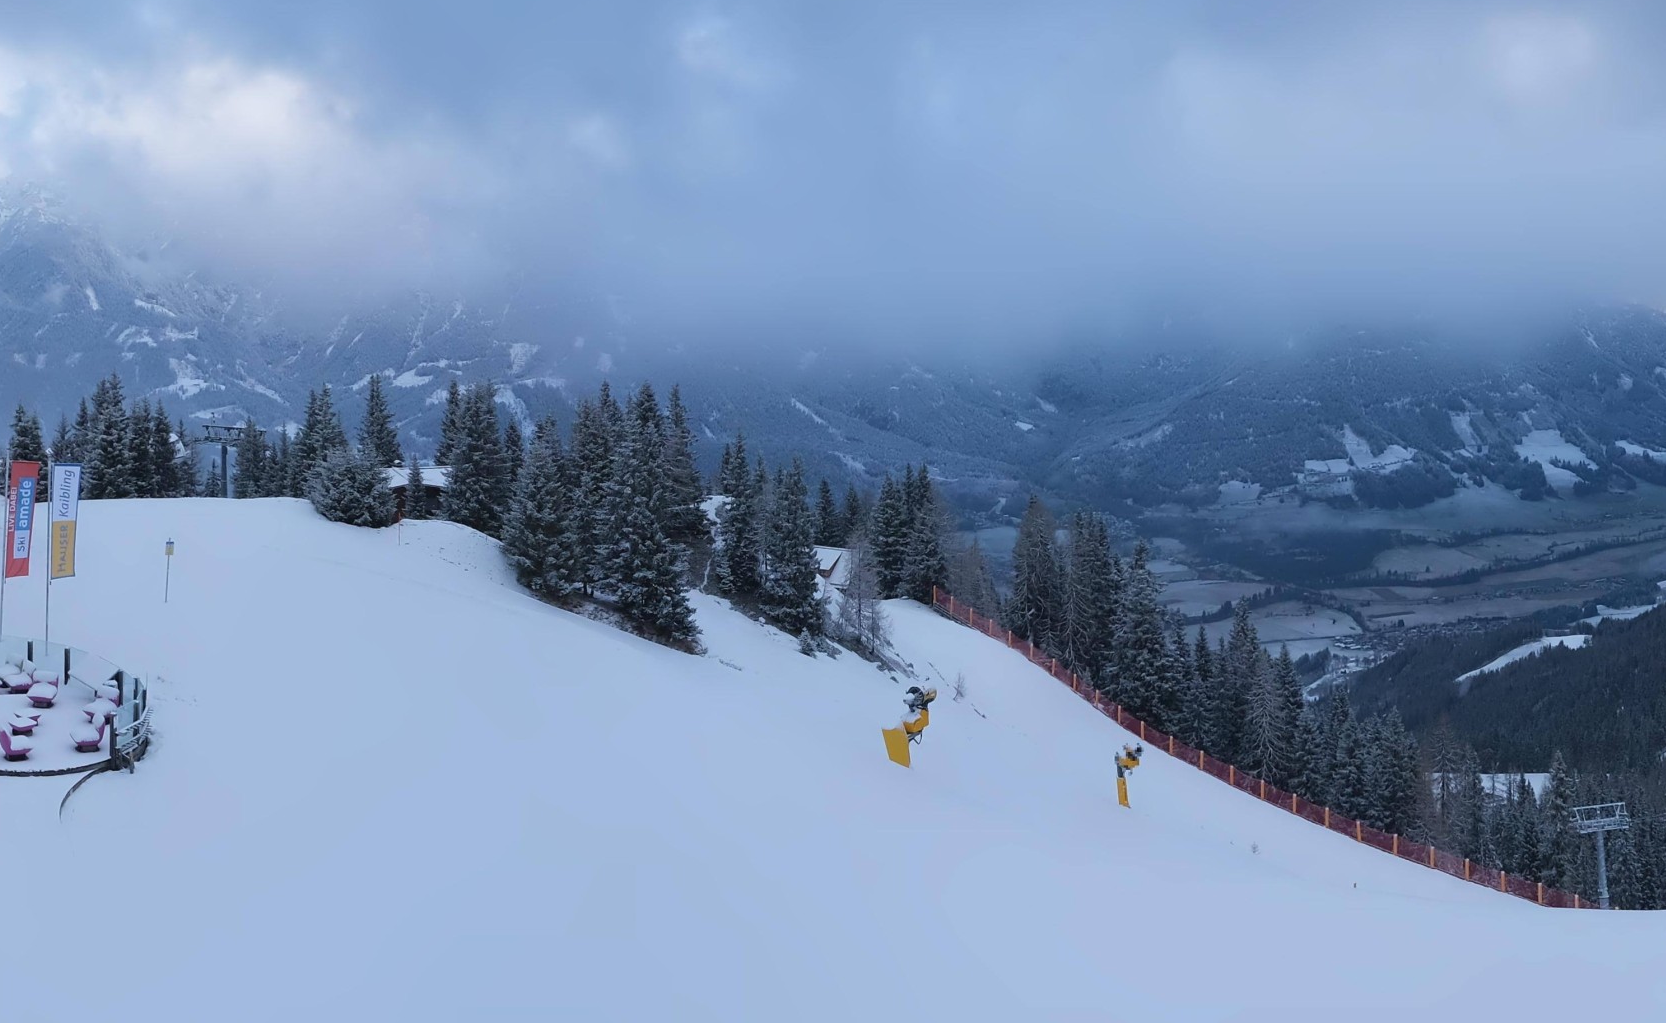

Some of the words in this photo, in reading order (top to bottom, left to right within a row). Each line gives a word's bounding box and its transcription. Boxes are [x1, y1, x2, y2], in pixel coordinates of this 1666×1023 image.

[9, 487, 18, 511] DABEI
[59, 470, 75, 518] Kaibling
[17, 537, 26, 552] Ski
[57, 525, 68, 572] HAUSER
